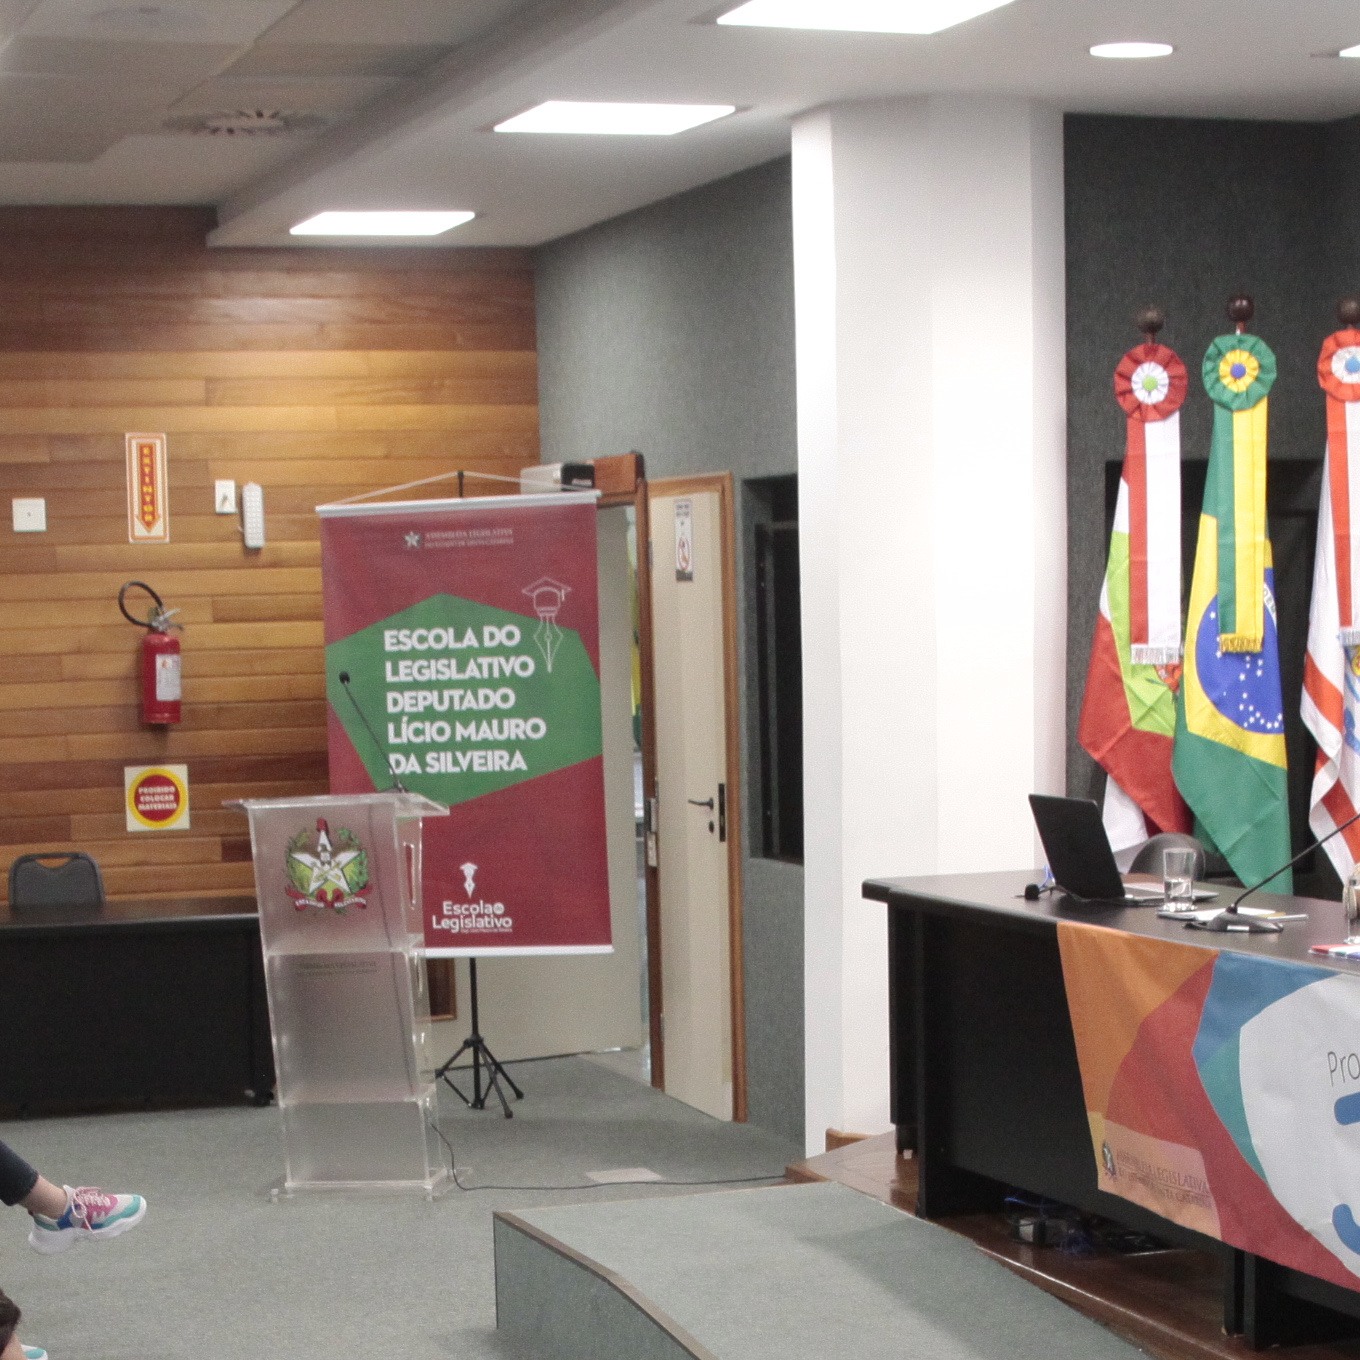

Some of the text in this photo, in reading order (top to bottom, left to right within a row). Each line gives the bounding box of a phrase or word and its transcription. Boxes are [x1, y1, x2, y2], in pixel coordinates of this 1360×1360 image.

[384, 624, 521, 652] ESCOLA DO
[385, 655, 535, 683] LEGISLATIVO
[386, 687, 516, 713] DEPUTADO
[387, 715, 547, 744] LÍCIO MAURO
[388, 749, 528, 775] DA SILVEIRA
[443, 899, 493, 915] Escola
[432, 914, 513, 934] Legislativo
